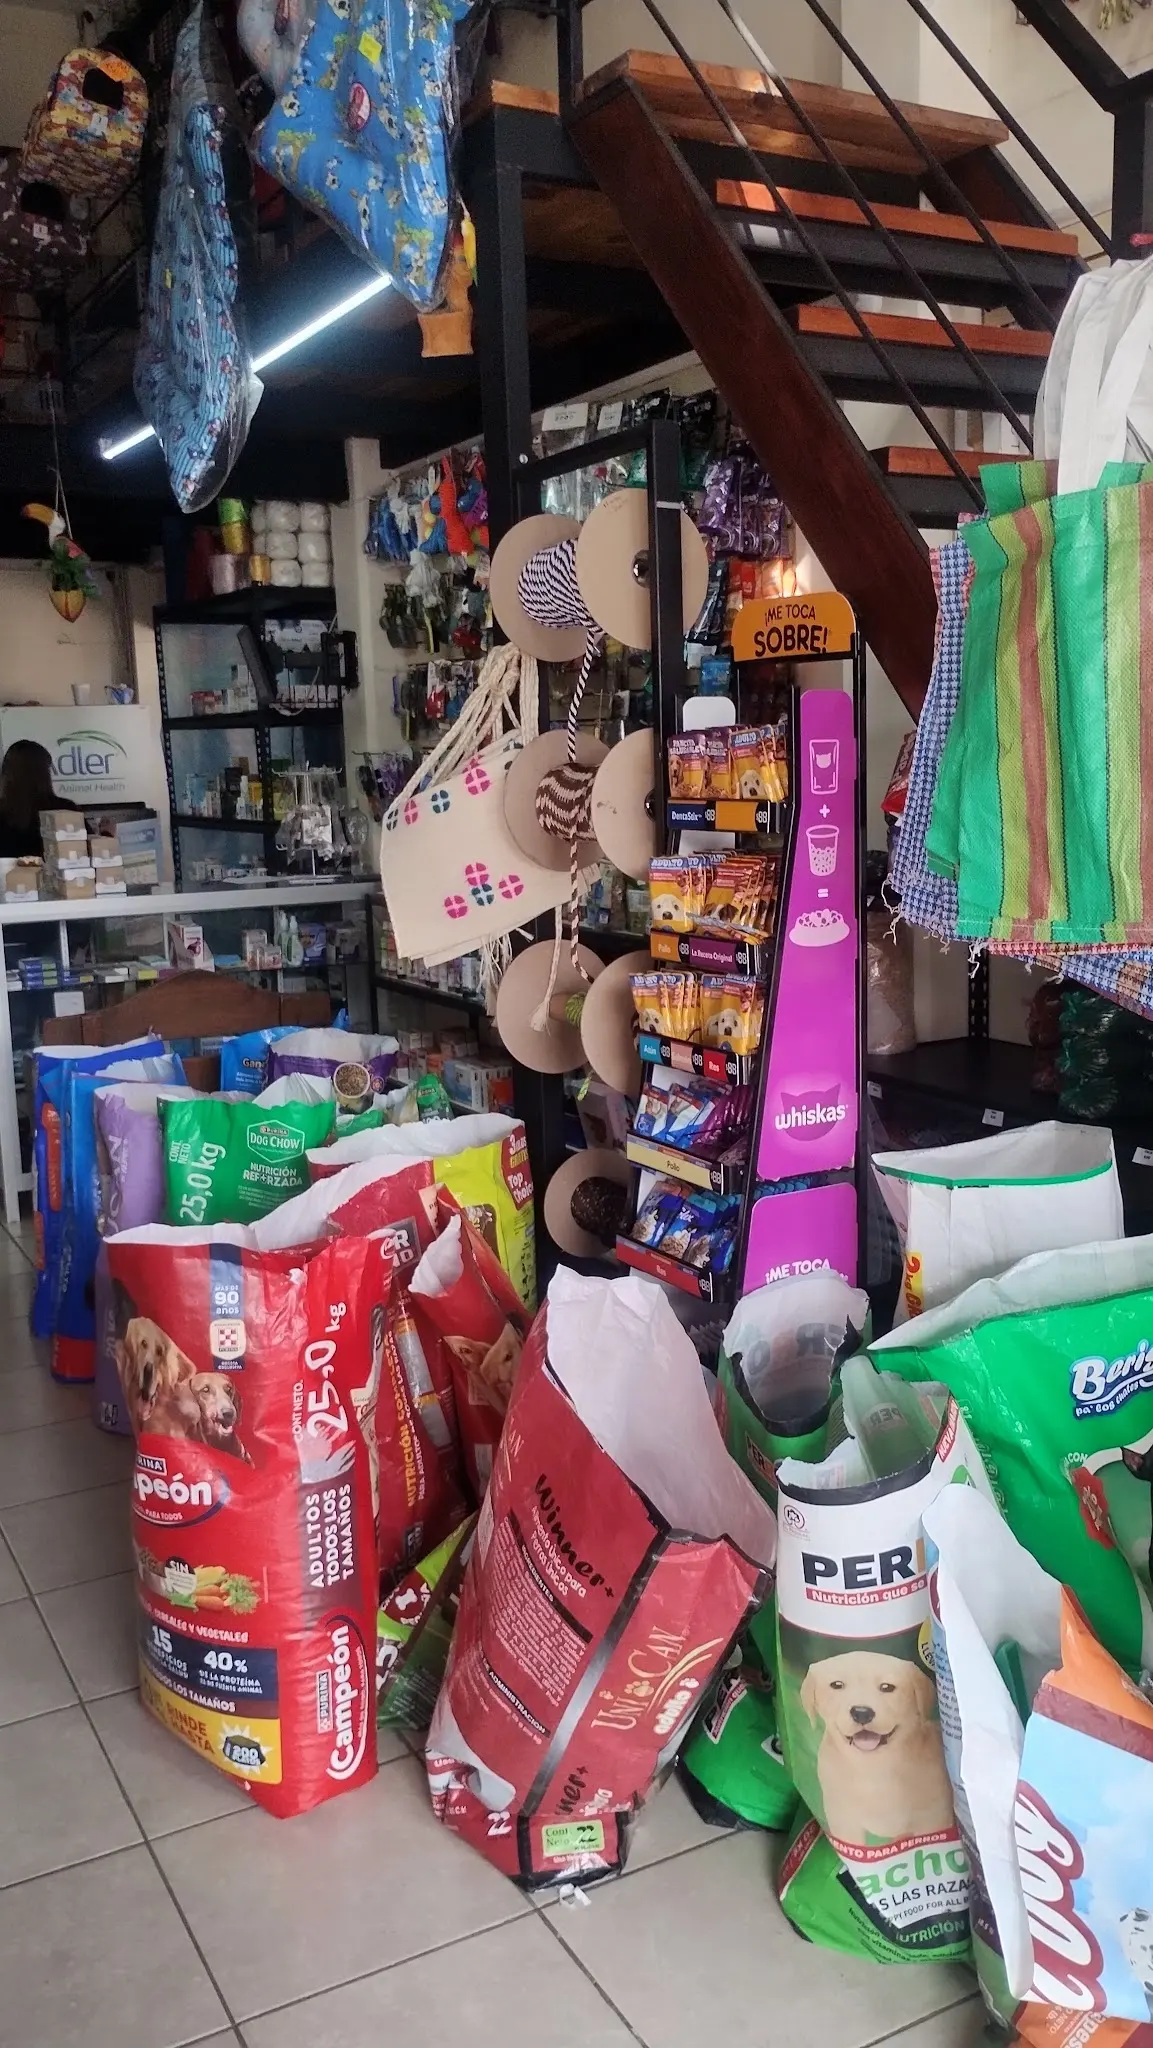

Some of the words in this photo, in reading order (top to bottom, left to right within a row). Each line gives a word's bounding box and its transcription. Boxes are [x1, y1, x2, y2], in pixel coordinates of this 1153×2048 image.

[785, 603, 816, 620] TOCA
[753, 624, 828, 657] SOBRE!
[59, 783, 92, 793] Animal
[95, 782, 126, 792] Health
[713, 952, 733, 964] Original
[774, 1102, 846, 1131] whiskas
[190, 1142, 226, 1171] kg
[269, 1136, 301, 1150] CHOW
[250, 1162, 297, 1178] NUTRICIÓN
[180, 1173, 213, 1223] 25,0
[214, 1291, 239, 1306] 90
[216, 1304, 240, 1316] años
[324, 1301, 347, 1333] kg
[304, 1340, 348, 1438] 25,0
[161, 1511, 183, 1520] TODOS
[323, 1488, 337, 1523] LOS
[305, 1493, 325, 1588] ADULTOS
[337, 1483, 355, 1581] TAMAÑOS
[168, 1560, 190, 1575] SIN
[324, 1523, 341, 1587] TODOS
[564, 1572, 588, 1599] para
[811, 1590, 880, 1606] Nutrición
[882, 1584, 908, 1603] que
[151, 1625, 173, 1655] 15
[196, 1625, 249, 1644] VEGETALES
[210, 1671, 220, 1680] LA
[220, 1674, 261, 1687] PROTEÍNA
[173, 1682, 187, 1697] LOS
[189, 1689, 236, 1713] TAMAÑOS
[318, 1671, 329, 1719] PURINA
[326, 1625, 359, 1771] Campeón
[486, 1811, 513, 1837] 22
[866, 1845, 899, 1860] PARA
[900, 1832, 948, 1851] PERROS
[892, 1887, 922, 1907] LAS
[903, 1905, 924, 1918] FOOD
[926, 1901, 944, 1910] FOR
[945, 1897, 962, 1907] ALL
